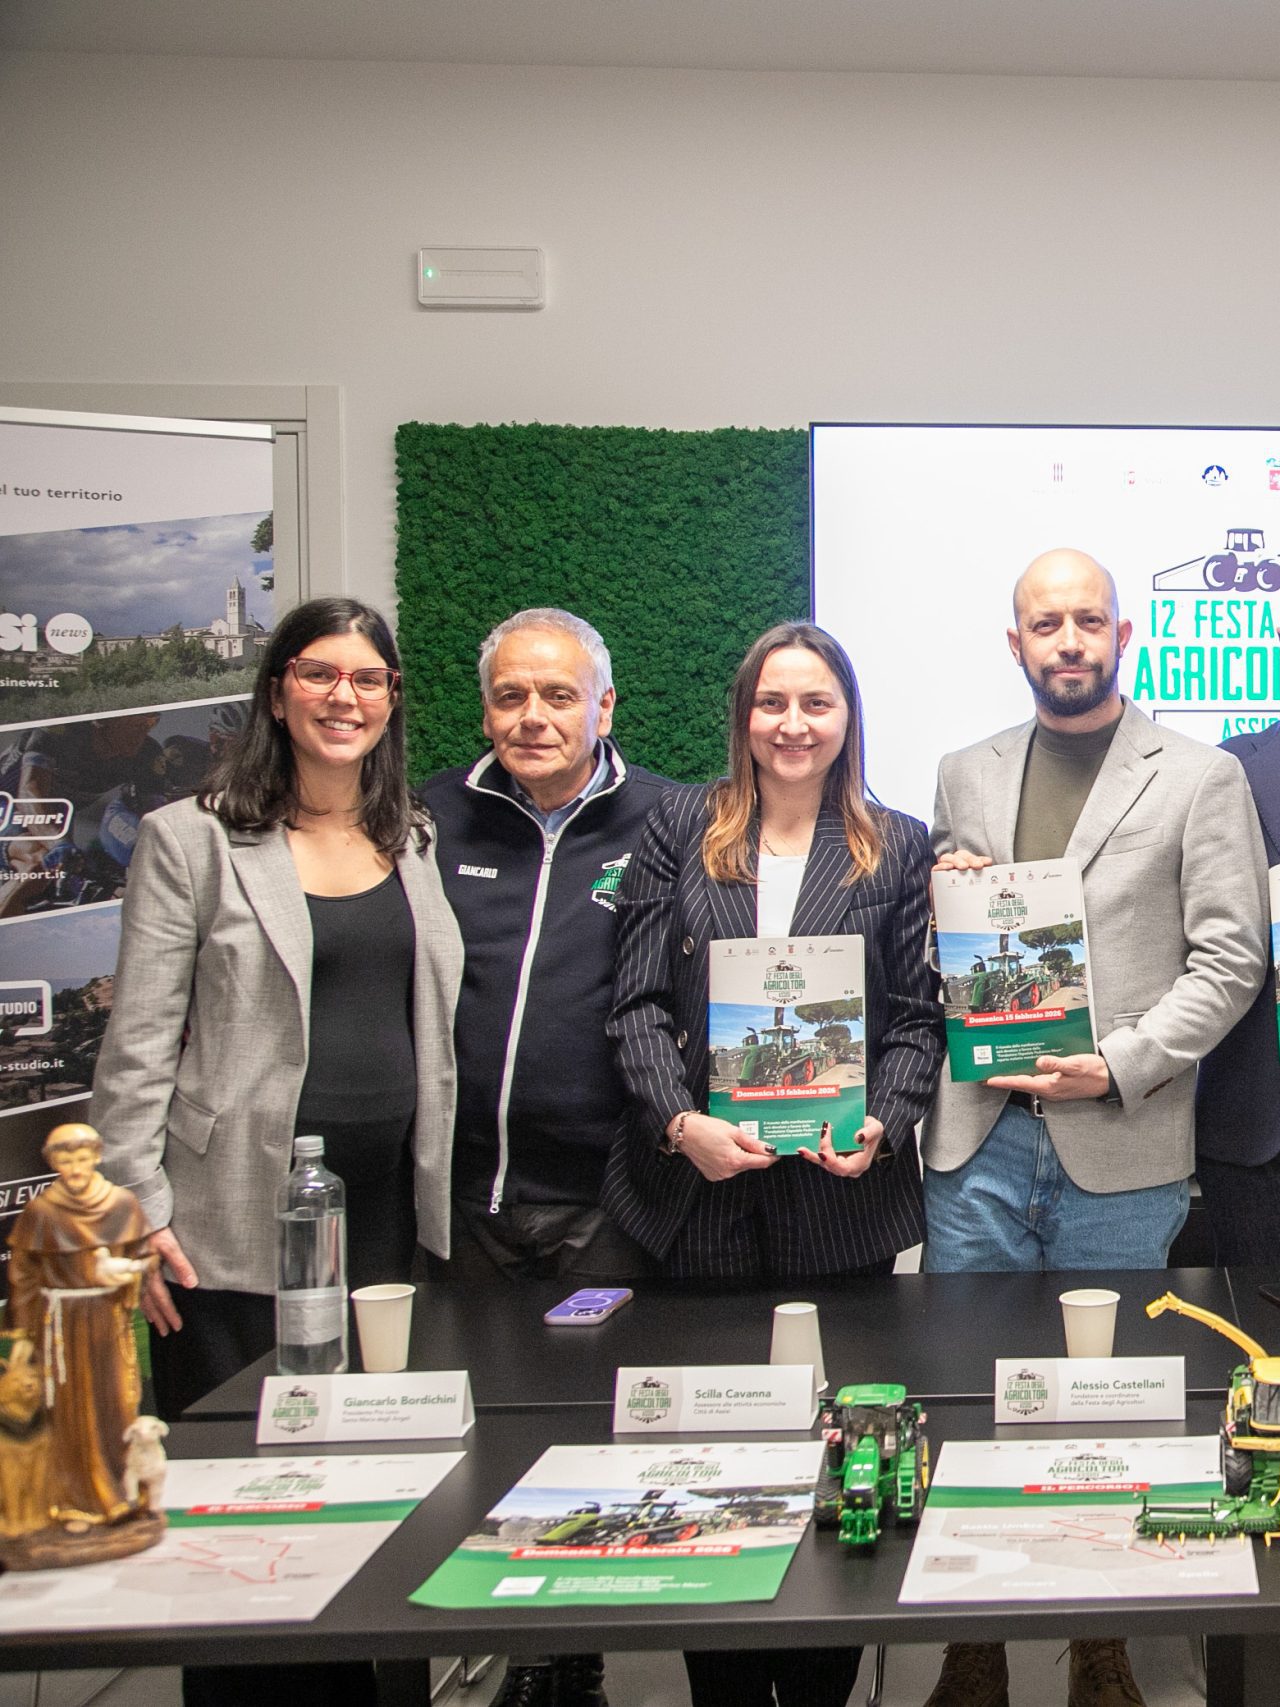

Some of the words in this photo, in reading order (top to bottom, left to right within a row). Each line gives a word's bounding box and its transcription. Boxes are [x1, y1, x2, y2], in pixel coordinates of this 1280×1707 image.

[13, 487, 41, 497] tuo
[47, 488, 123, 501] territorio
[1195, 600, 1275, 638] FESTA
[50, 629, 88, 638] news
[11, 812, 64, 828] sport
[458, 864, 498, 879] GIANCARLO
[605, 868, 624, 878] FEST
[988, 906, 1027, 918] AGRICOLTORI
[763, 979, 805, 990] AGRICOLTORI
[969, 1015, 1004, 1024] Domenica
[1015, 1011, 1043, 1020] febbraio
[0, 1059, 65, 1071] -studio.it
[736, 1089, 774, 1098] Domenica
[786, 1087, 817, 1095] febbraio
[818, 1086, 836, 1094] 2026
[1015, 1381, 1030, 1389] FESTA
[1071, 1380, 1110, 1390] Alessio
[1113, 1379, 1165, 1389] Castellani
[695, 1389, 722, 1399] Scilla
[725, 1389, 772, 1399] Cavanna
[1004, 1389, 1048, 1400] AGRICOLTORI
[344, 1395, 397, 1407] Giancarlo
[401, 1393, 457, 1406] Bordichini
[627, 1397, 672, 1408] AGRICOLTORI
[1048, 1465, 1129, 1473] AGRICOLTORI
[521, 1548, 602, 1557] Domenica
[626, 1546, 691, 1555] febbraio
